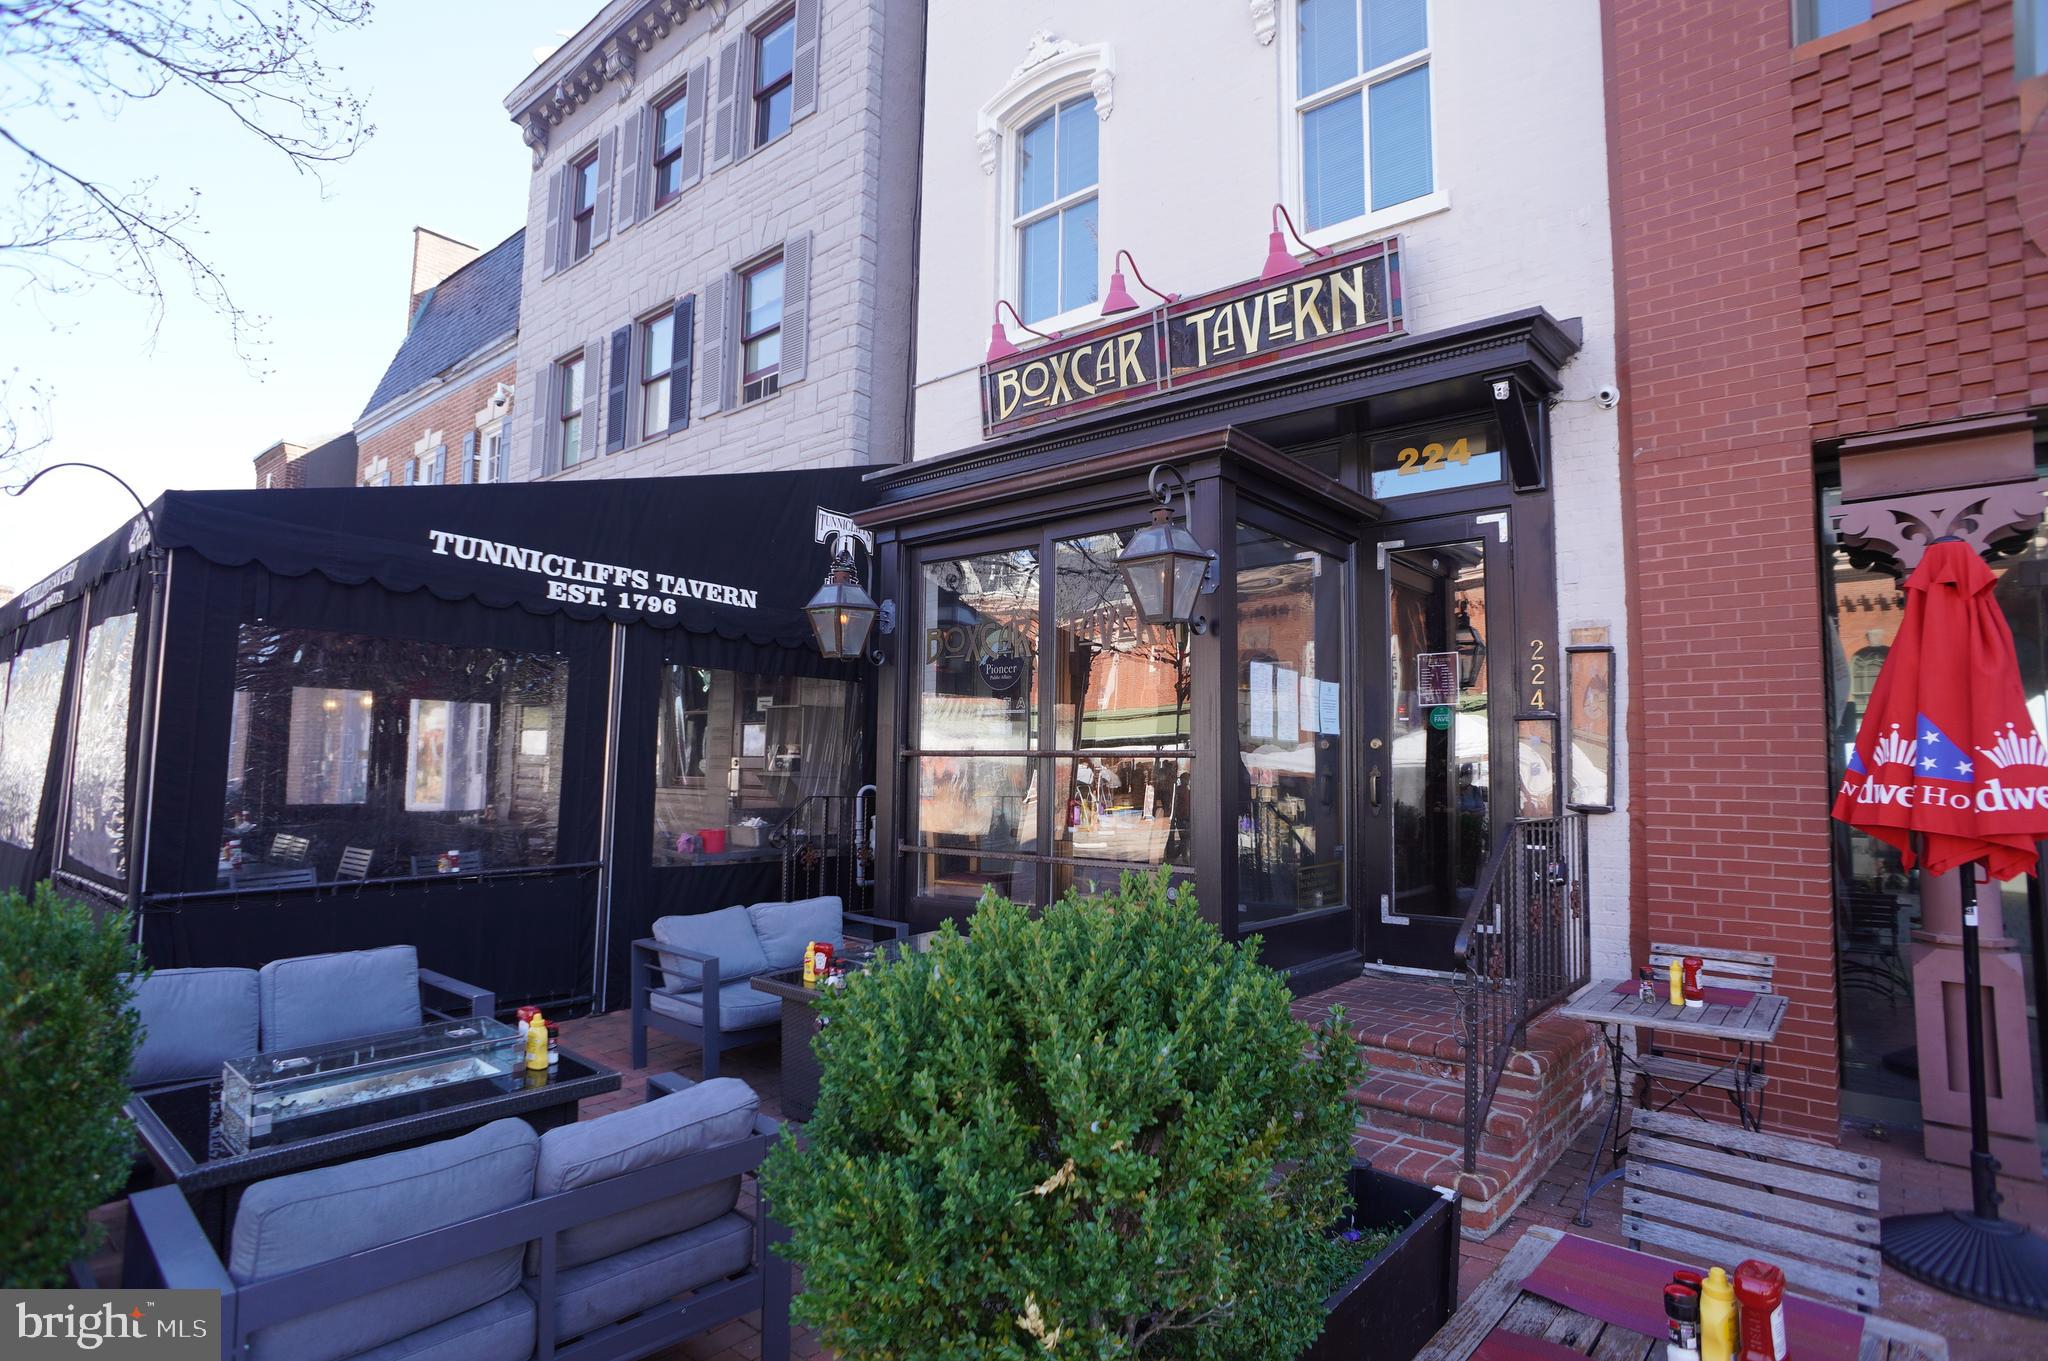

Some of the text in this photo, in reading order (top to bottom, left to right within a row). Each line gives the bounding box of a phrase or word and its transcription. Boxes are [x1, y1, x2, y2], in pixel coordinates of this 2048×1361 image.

[998, 265, 1367, 420] BOXCAR TAVERN
[1397, 437, 1472, 475] 224
[429, 529, 758, 609] TUNNICLIFFS TAVERN
[546, 580, 677, 615] EST. 1796
[926, 619, 1033, 665] BOXCAR
[986, 663, 1018, 675] Pioneer
